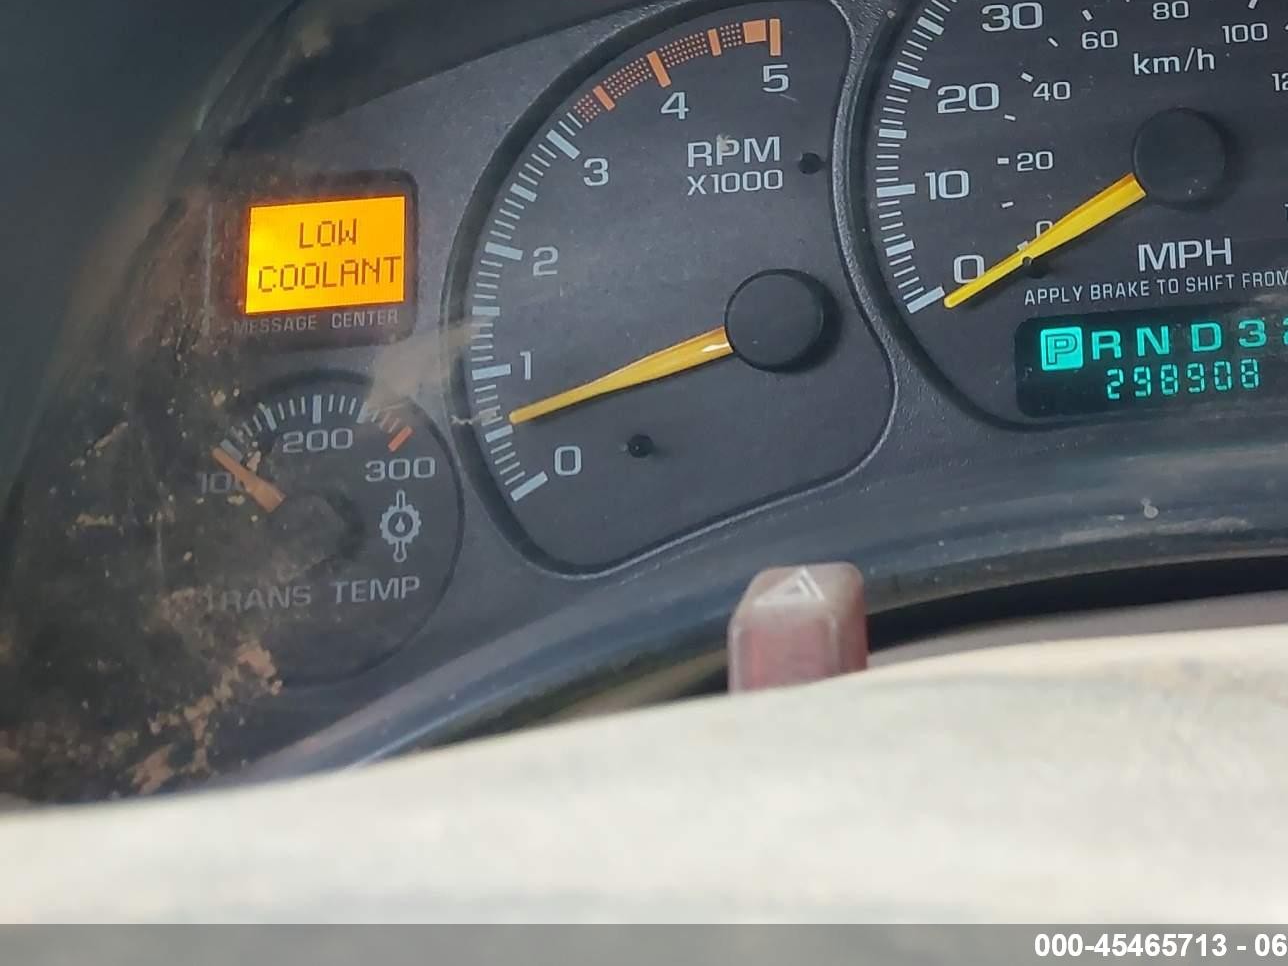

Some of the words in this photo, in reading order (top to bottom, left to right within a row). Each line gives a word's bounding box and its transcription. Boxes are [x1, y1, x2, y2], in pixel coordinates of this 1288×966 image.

[982, 2, 1044, 31] 30
[1152, 1, 1190, 20] 80
[1081, 30, 1119, 50] 60
[1222, 22, 1268, 44] 100
[1133, 49, 1216, 76] km/h
[761, 63, 790, 94] 5
[1033, 81, 1071, 102] 40
[660, 91, 690, 120] 4
[936, 83, 1000, 113] 20
[687, 137, 781, 168] RPM
[1016, 151, 1054, 172] 20
[582, 159, 610, 187] 3
[687, 169, 784, 196] X1000
[924, 170, 970, 201] 10
[299, 218, 358, 249] LOW
[532, 246, 559, 276] 2
[953, 254, 985, 284] 0
[1137, 238, 1232, 272] MPH
[258, 256, 401, 294] COOLANT
[1024, 285, 1083, 306] APPLY
[1090, 279, 1150, 300] BRAKE
[1156, 277, 1180, 295] TO
[1185, 273, 1236, 293] SHIFT
[232, 315, 317, 334] MESSAGE
[331, 309, 399, 329] CENTER
[1046, 333, 1079, 365] P
[1091, 330, 1123, 360] R
[1136, 325, 1170, 357] N
[1190, 322, 1222, 353] D
[1238, 318, 1266, 348] 3
[519, 351, 531, 380] 1
[1106, 357, 1260, 401] 298908
[282, 428, 353, 453] 200
[365, 456, 436, 482] 300
[554, 445, 582, 475] 0
[196, 472, 246, 494] 10
[202, 584, 311, 612] TRANS
[334, 576, 421, 604] TEMP
